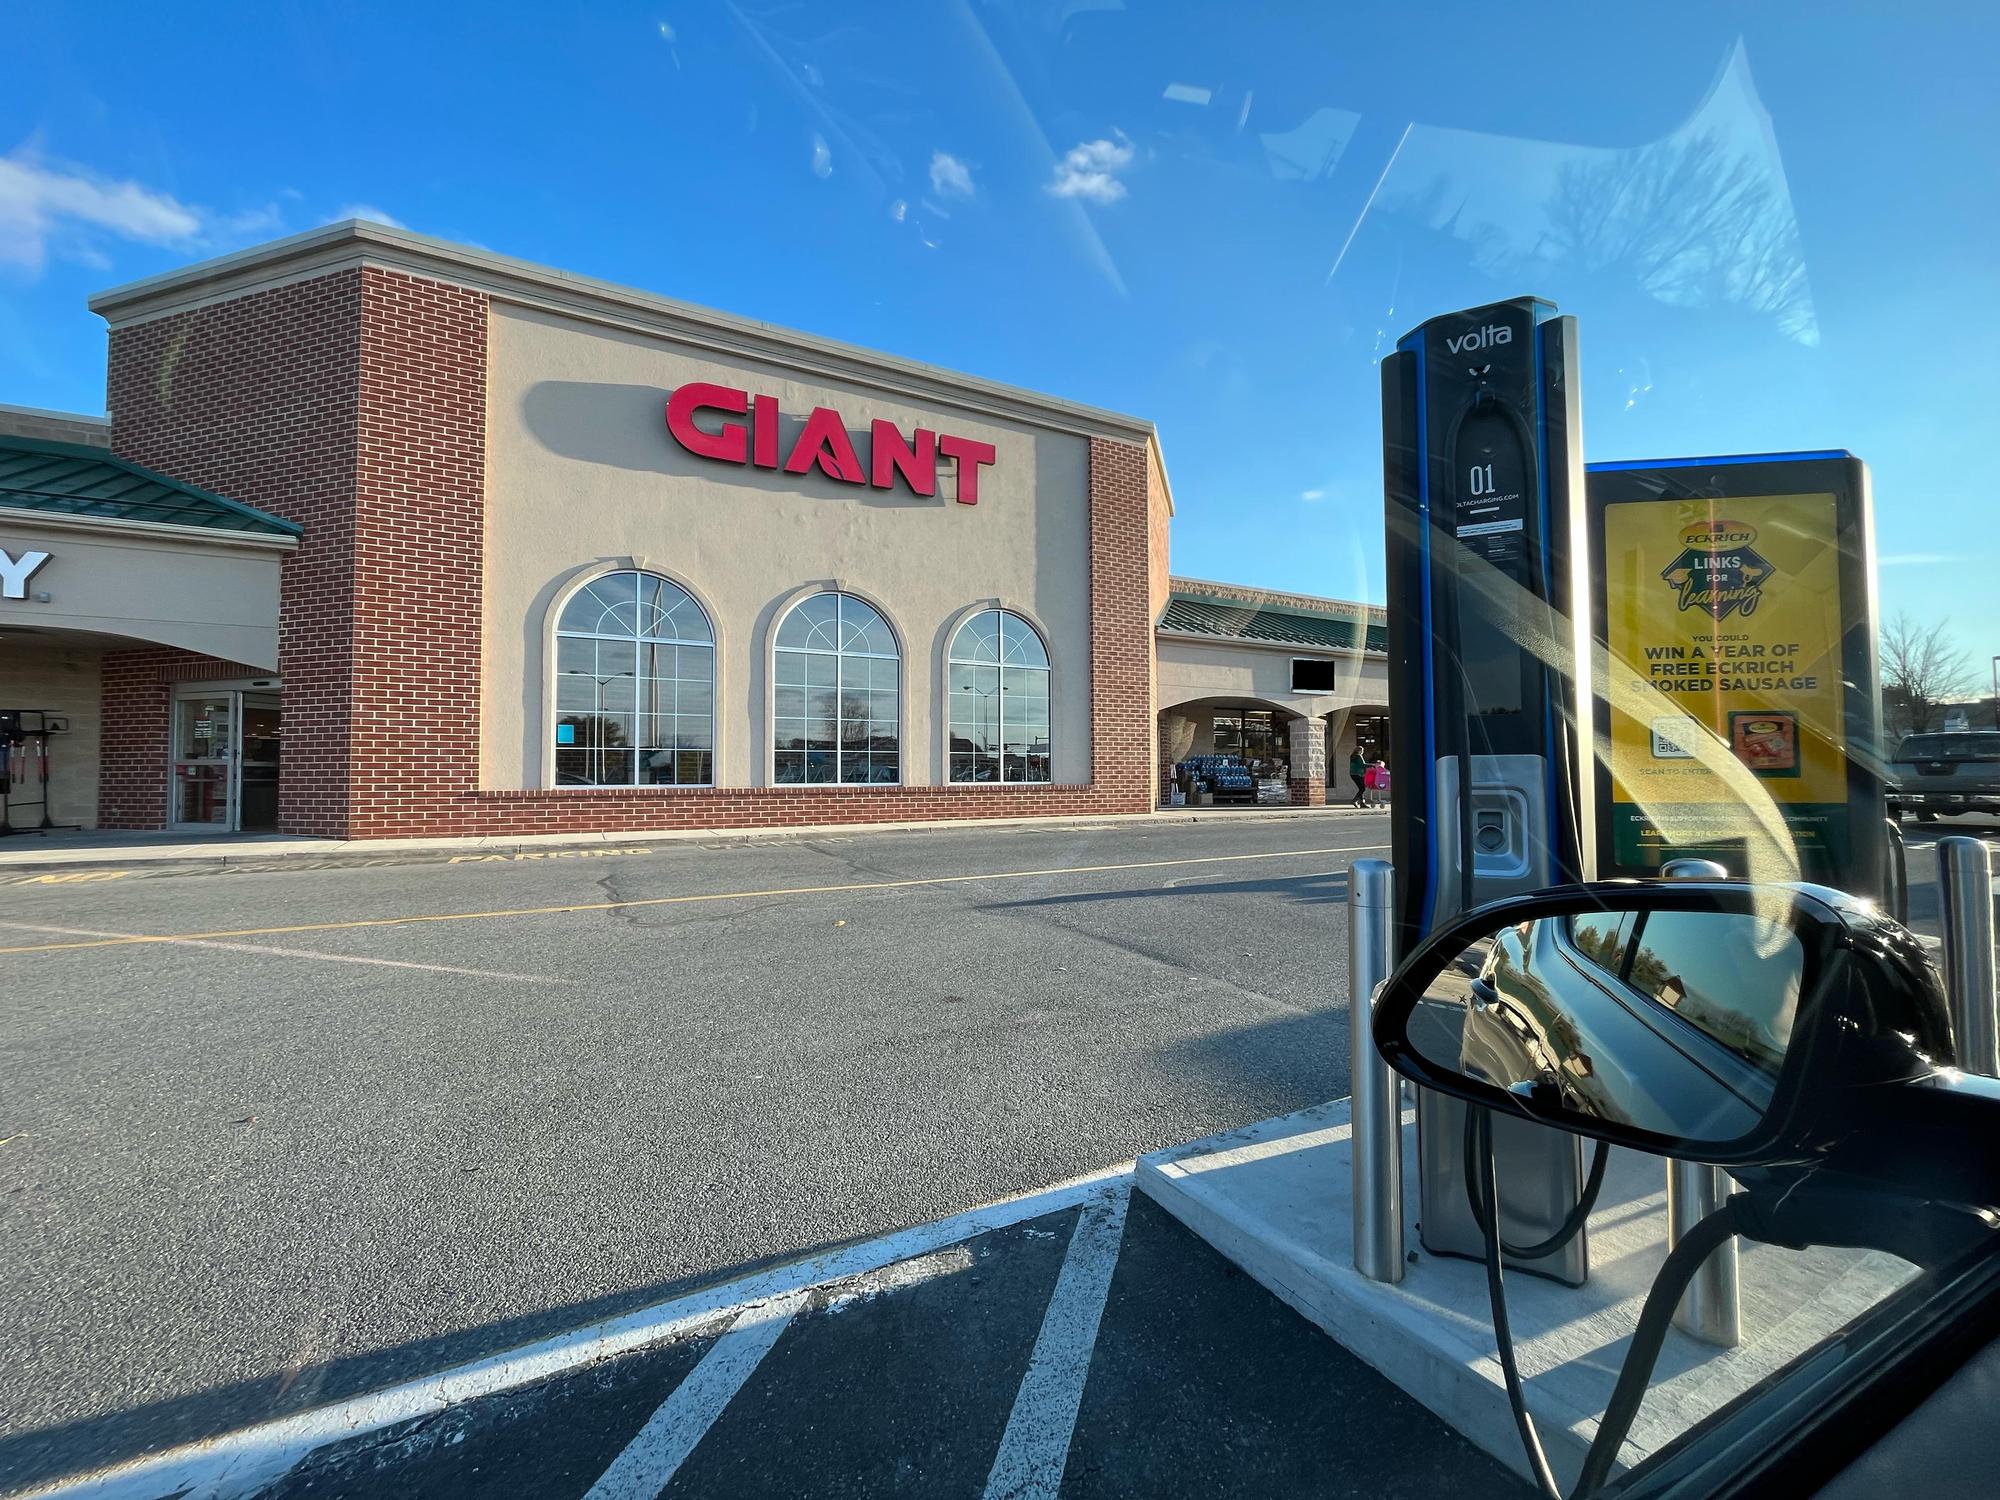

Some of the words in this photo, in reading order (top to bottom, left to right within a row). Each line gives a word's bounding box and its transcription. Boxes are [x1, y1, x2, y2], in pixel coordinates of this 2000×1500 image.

[1446, 324, 1512, 354] volta
[665, 382, 996, 505] GIANT
[1470, 464, 1496, 496] 01
[1685, 533, 1750, 543] ECKRICH
[1694, 556, 1742, 570] LINKS
[1706, 574, 1728, 582] FOR
[1680, 576, 1762, 615] learning
[1716, 634, 1749, 642] COULD
[1644, 646, 1685, 660] WIN
[1691, 646, 1705, 659] A
[1710, 644, 1765, 658] YEAR
[1771, 643, 1799, 657] OF
[1650, 663, 1699, 676] FREE
[1705, 660, 1794, 675] ECKRICH
[1631, 679, 1713, 692] SMOKED
[1719, 677, 1817, 691] SAUSAGE
[11, 871, 129, 886] NO
[447, 848, 654, 864] PARKING
